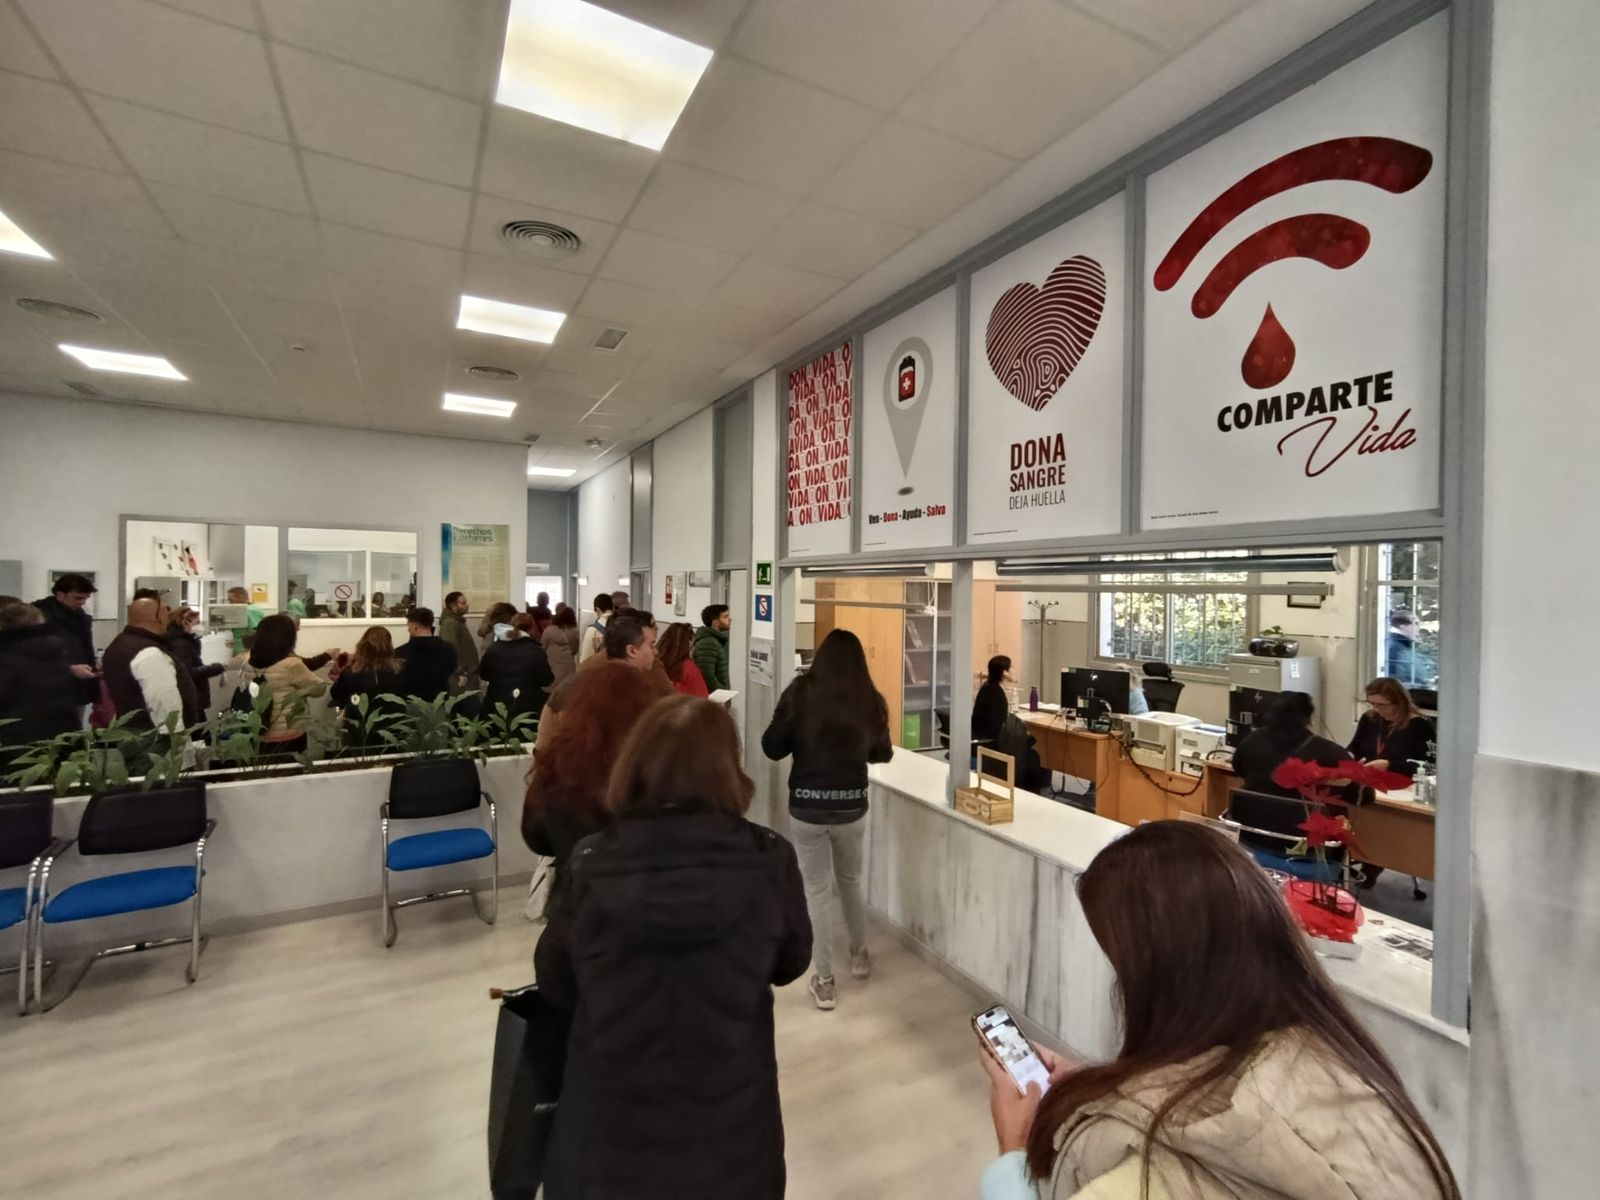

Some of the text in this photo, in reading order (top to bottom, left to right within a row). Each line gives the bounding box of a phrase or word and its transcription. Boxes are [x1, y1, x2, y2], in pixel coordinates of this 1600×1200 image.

[1217, 371, 1393, 432] COMPARTE
[1010, 433, 1066, 471] DONA
[1277, 405, 1417, 477] Vida
[1010, 464, 1066, 493] SANGRE
[1009, 489, 1066, 511] DEJA HUELLA
[869, 514, 880, 525] Ven
[883, 512, 898, 522] Dona
[902, 508, 921, 520] Ayuda
[926, 505, 945, 517] Salva
[795, 788, 862, 800] CONVERSE
